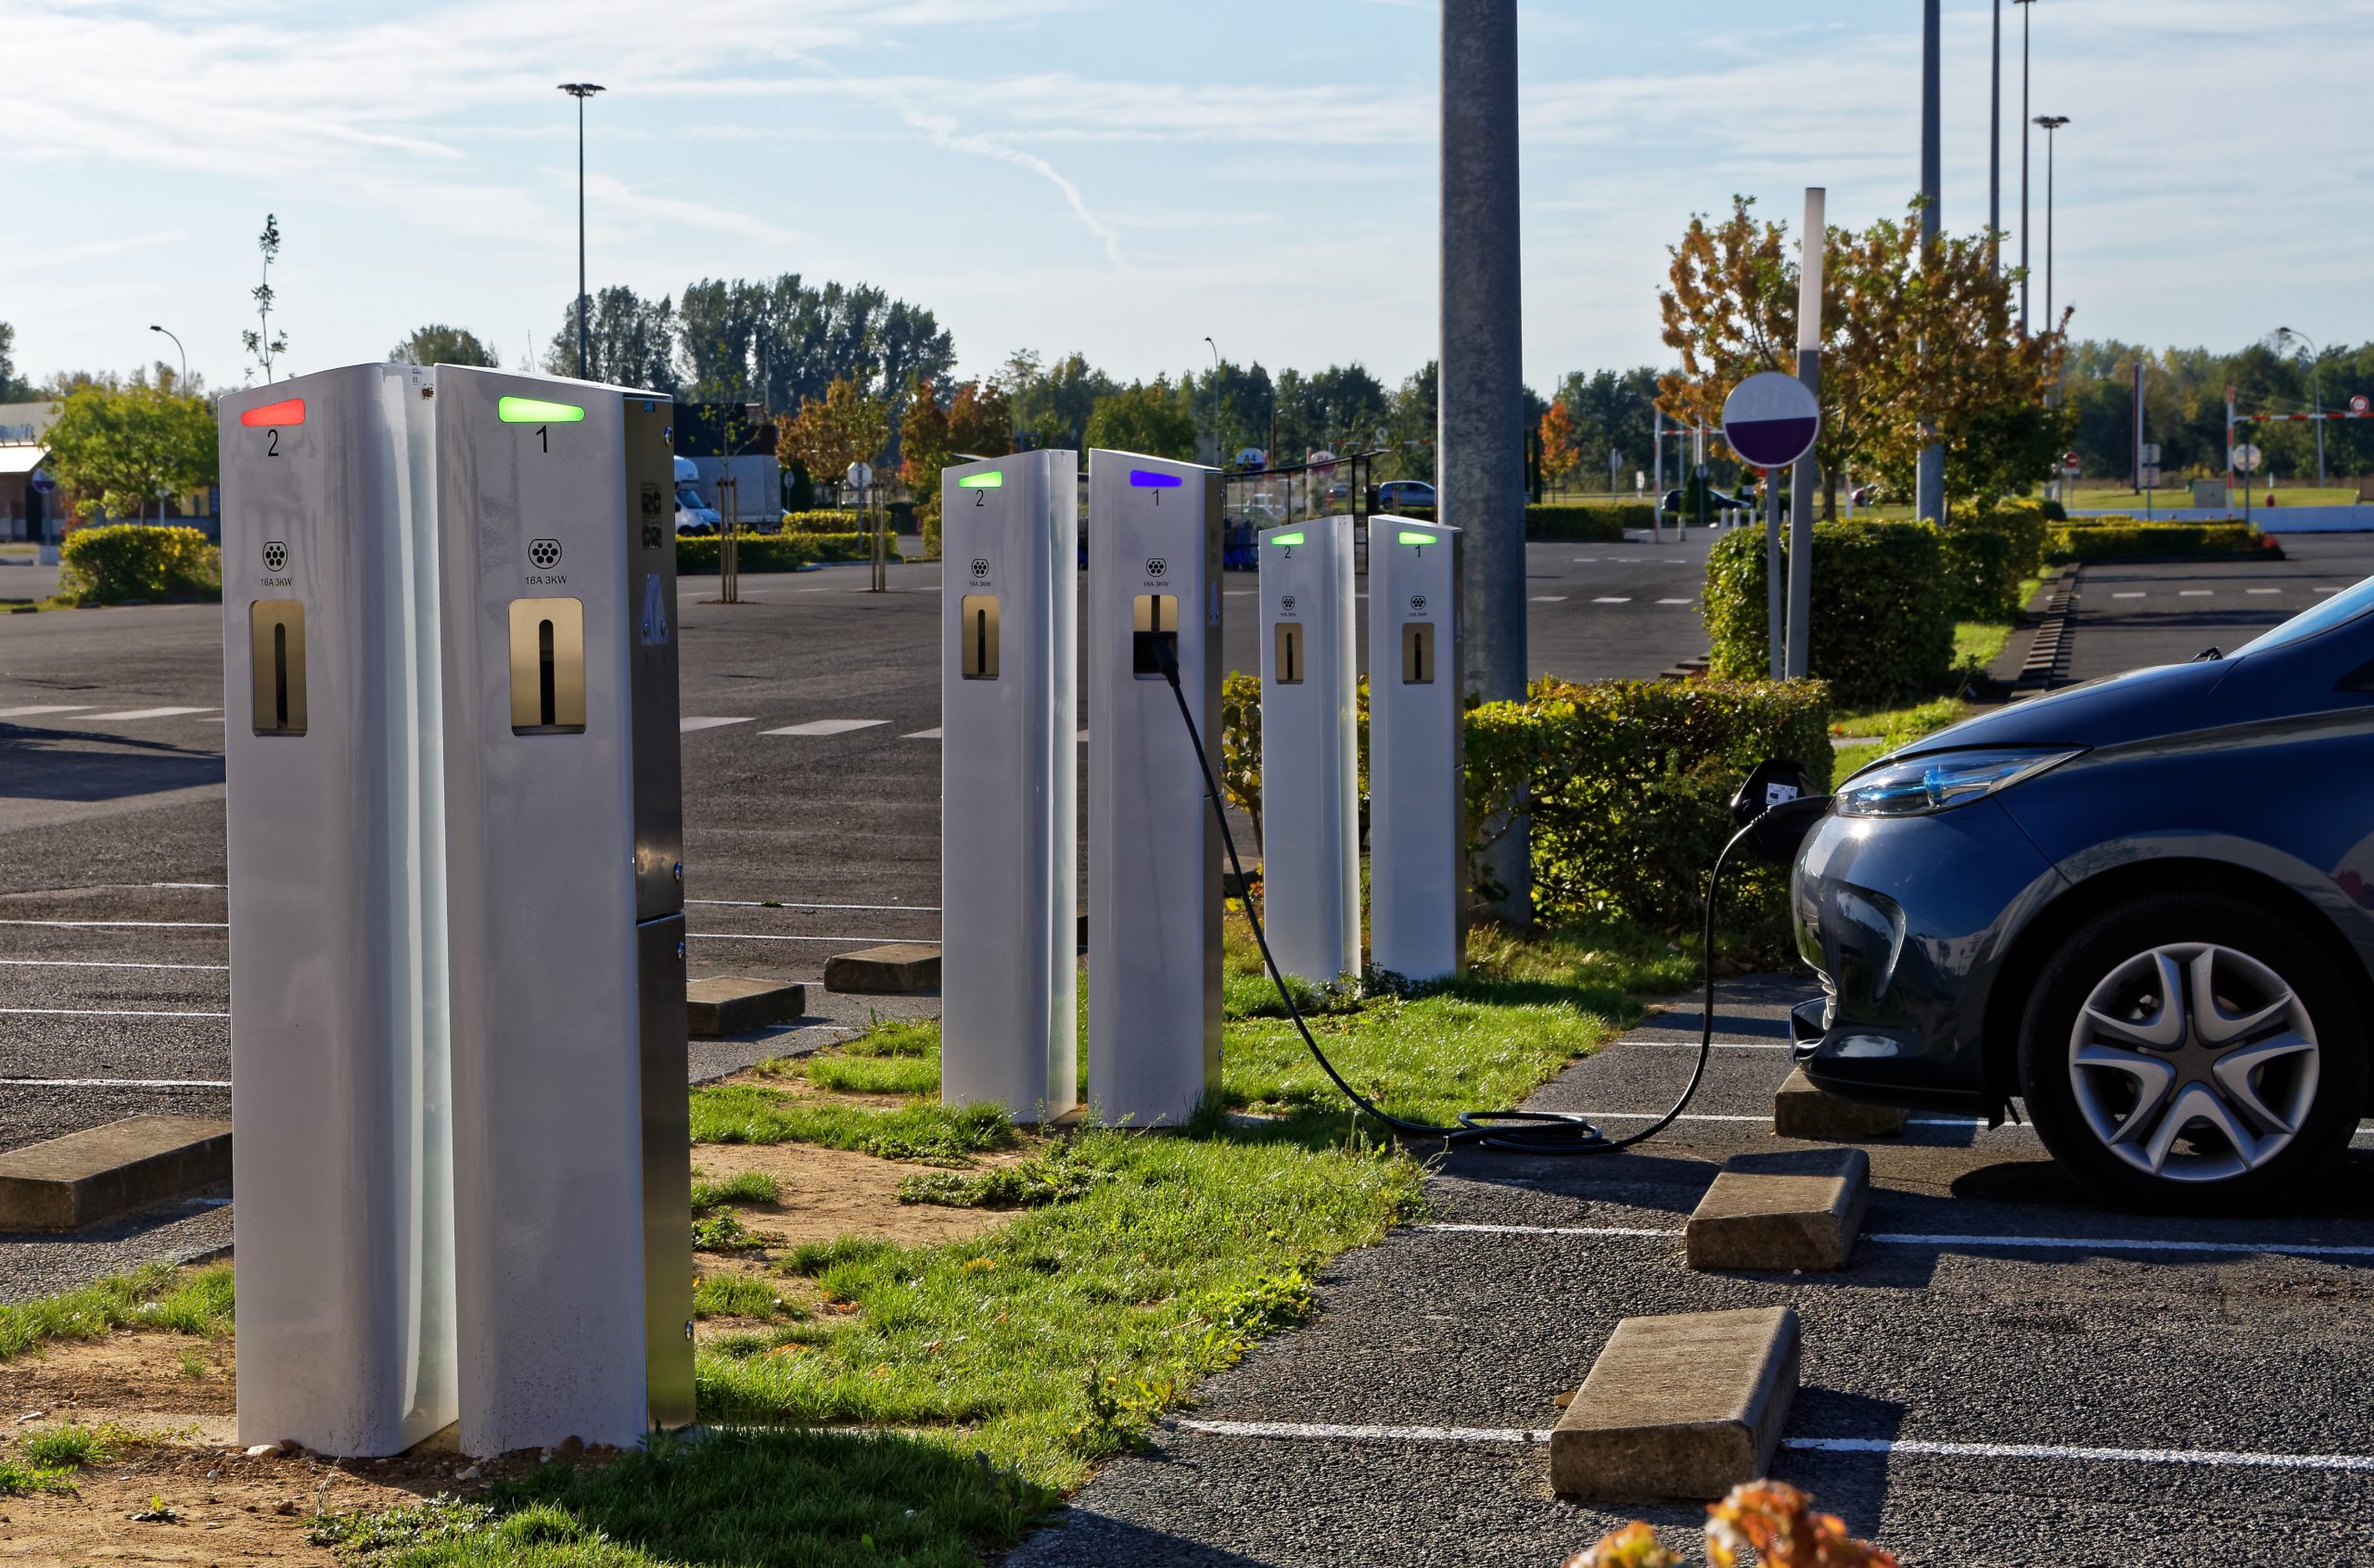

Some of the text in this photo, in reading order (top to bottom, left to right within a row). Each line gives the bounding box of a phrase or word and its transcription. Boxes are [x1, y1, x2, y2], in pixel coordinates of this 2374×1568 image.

[267, 429, 279, 456] 2
[536, 426, 548, 453] 1
[976, 490, 985, 506] 2
[1152, 489, 1159, 506] 1
[1284, 545, 1292, 558] 2
[1414, 545, 1421, 558] 1
[261, 578, 293, 587] 16A 3KW
[526, 576, 568, 585] 16A 3KW
